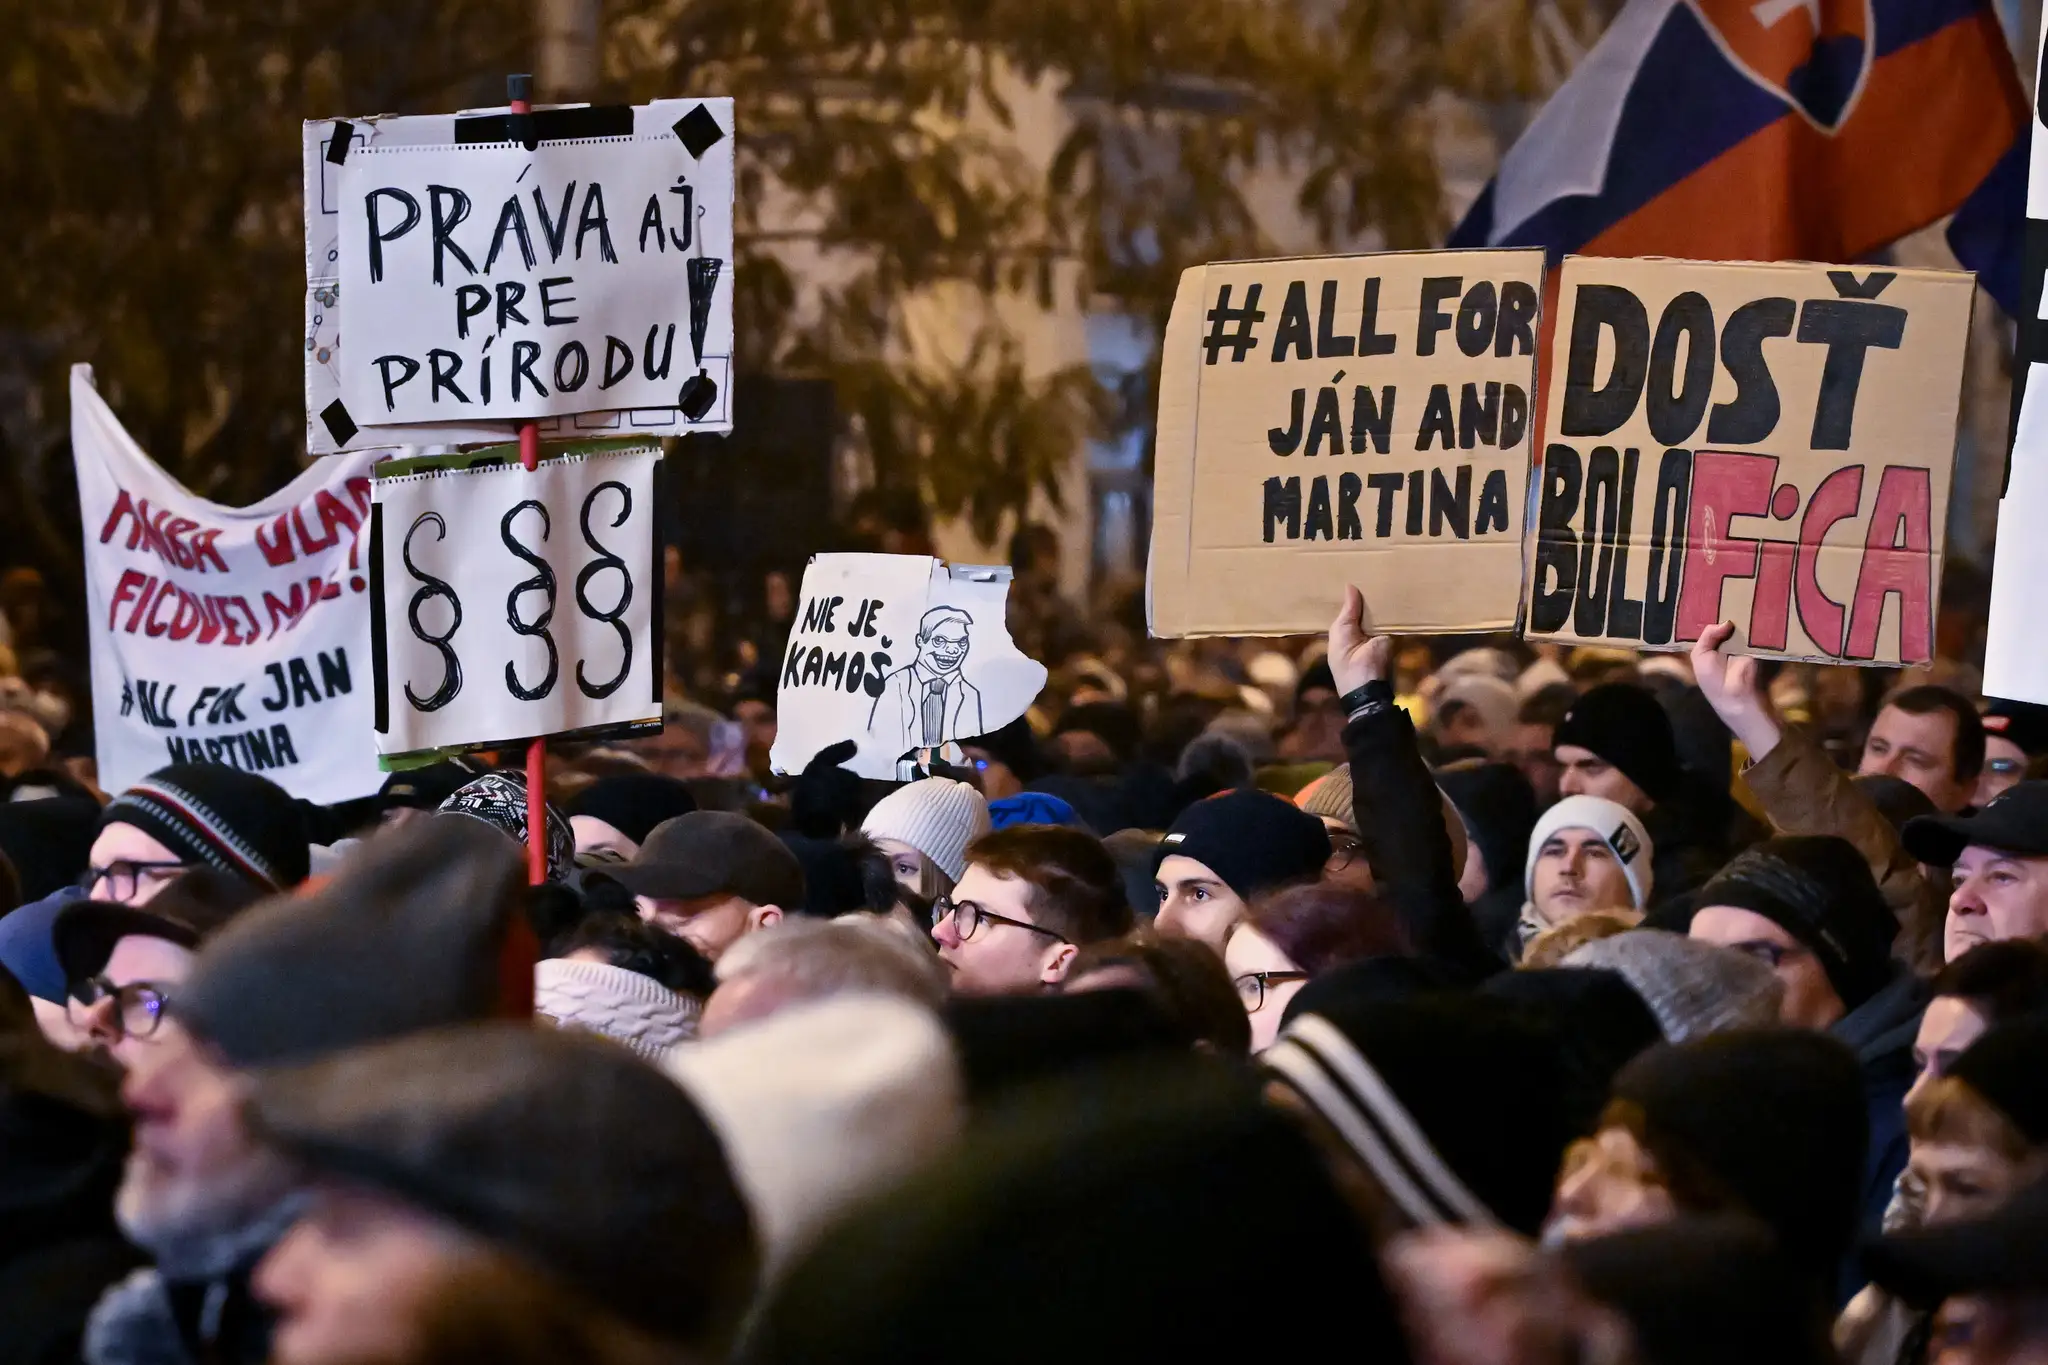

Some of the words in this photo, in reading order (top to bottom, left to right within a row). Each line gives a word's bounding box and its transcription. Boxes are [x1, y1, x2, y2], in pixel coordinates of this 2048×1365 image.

[365, 163, 618, 287] PRÁVA
[640, 175, 694, 253] AJ
[455, 276, 579, 340] PRE
[1202, 277, 1397, 365] #ALL
[1416, 276, 1540, 358] FOR
[1560, 271, 1908, 450] DOSŤ
[1267, 369, 1397, 458] JÁN
[1414, 380, 1529, 451] AND
[1262, 465, 1510, 543] MARTINA
[1530, 443, 1693, 645] BOLO
[801, 596, 844, 634] NIE
[848, 598, 884, 637] JE
[262, 647, 352, 712] JAN
[783, 635, 893, 698] KAMOŠ
[166, 723, 300, 771] MARTINA
